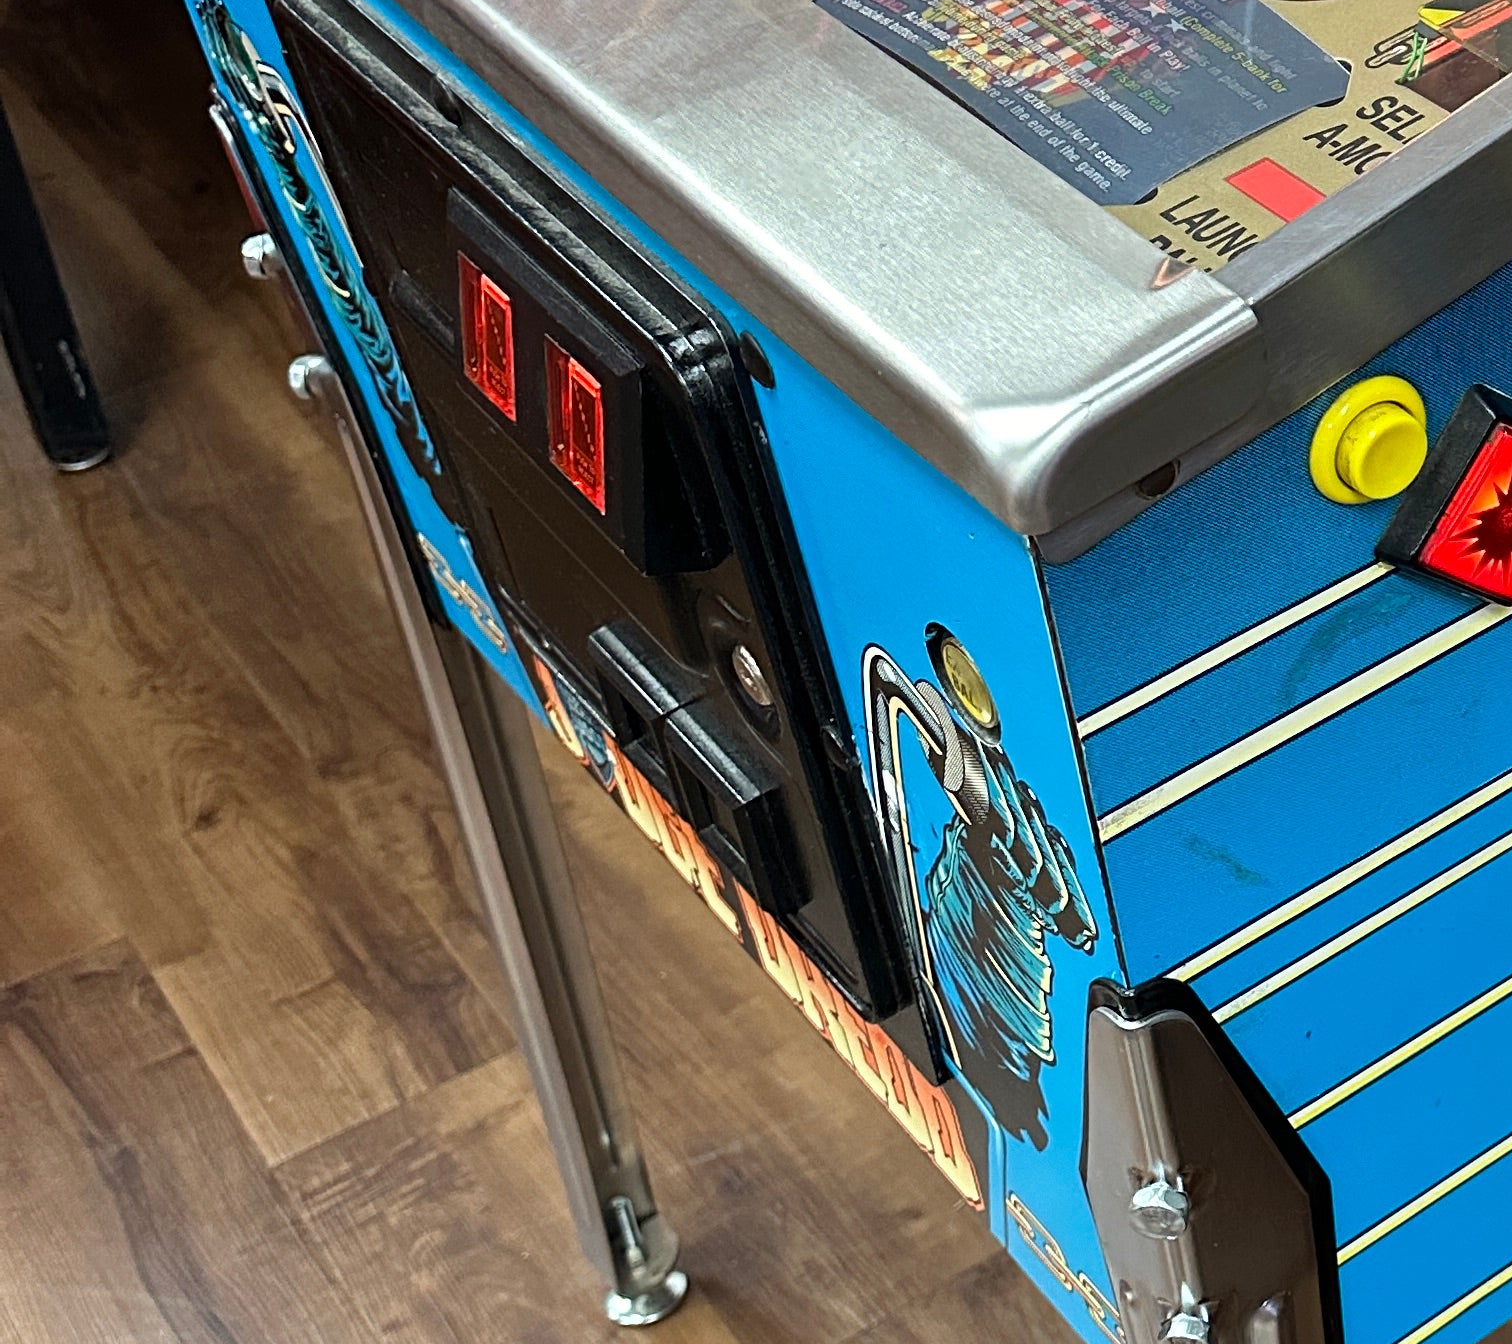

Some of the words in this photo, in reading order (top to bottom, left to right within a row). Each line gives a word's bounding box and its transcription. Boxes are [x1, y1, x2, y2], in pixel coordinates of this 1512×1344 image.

[1027, 119, 1051, 136] end
[1047, 135, 1063, 147] of
[1060, 146, 1082, 161] the
[532, 654, 744, 944] JDGE
[733, 876, 986, 1212] DREDD
